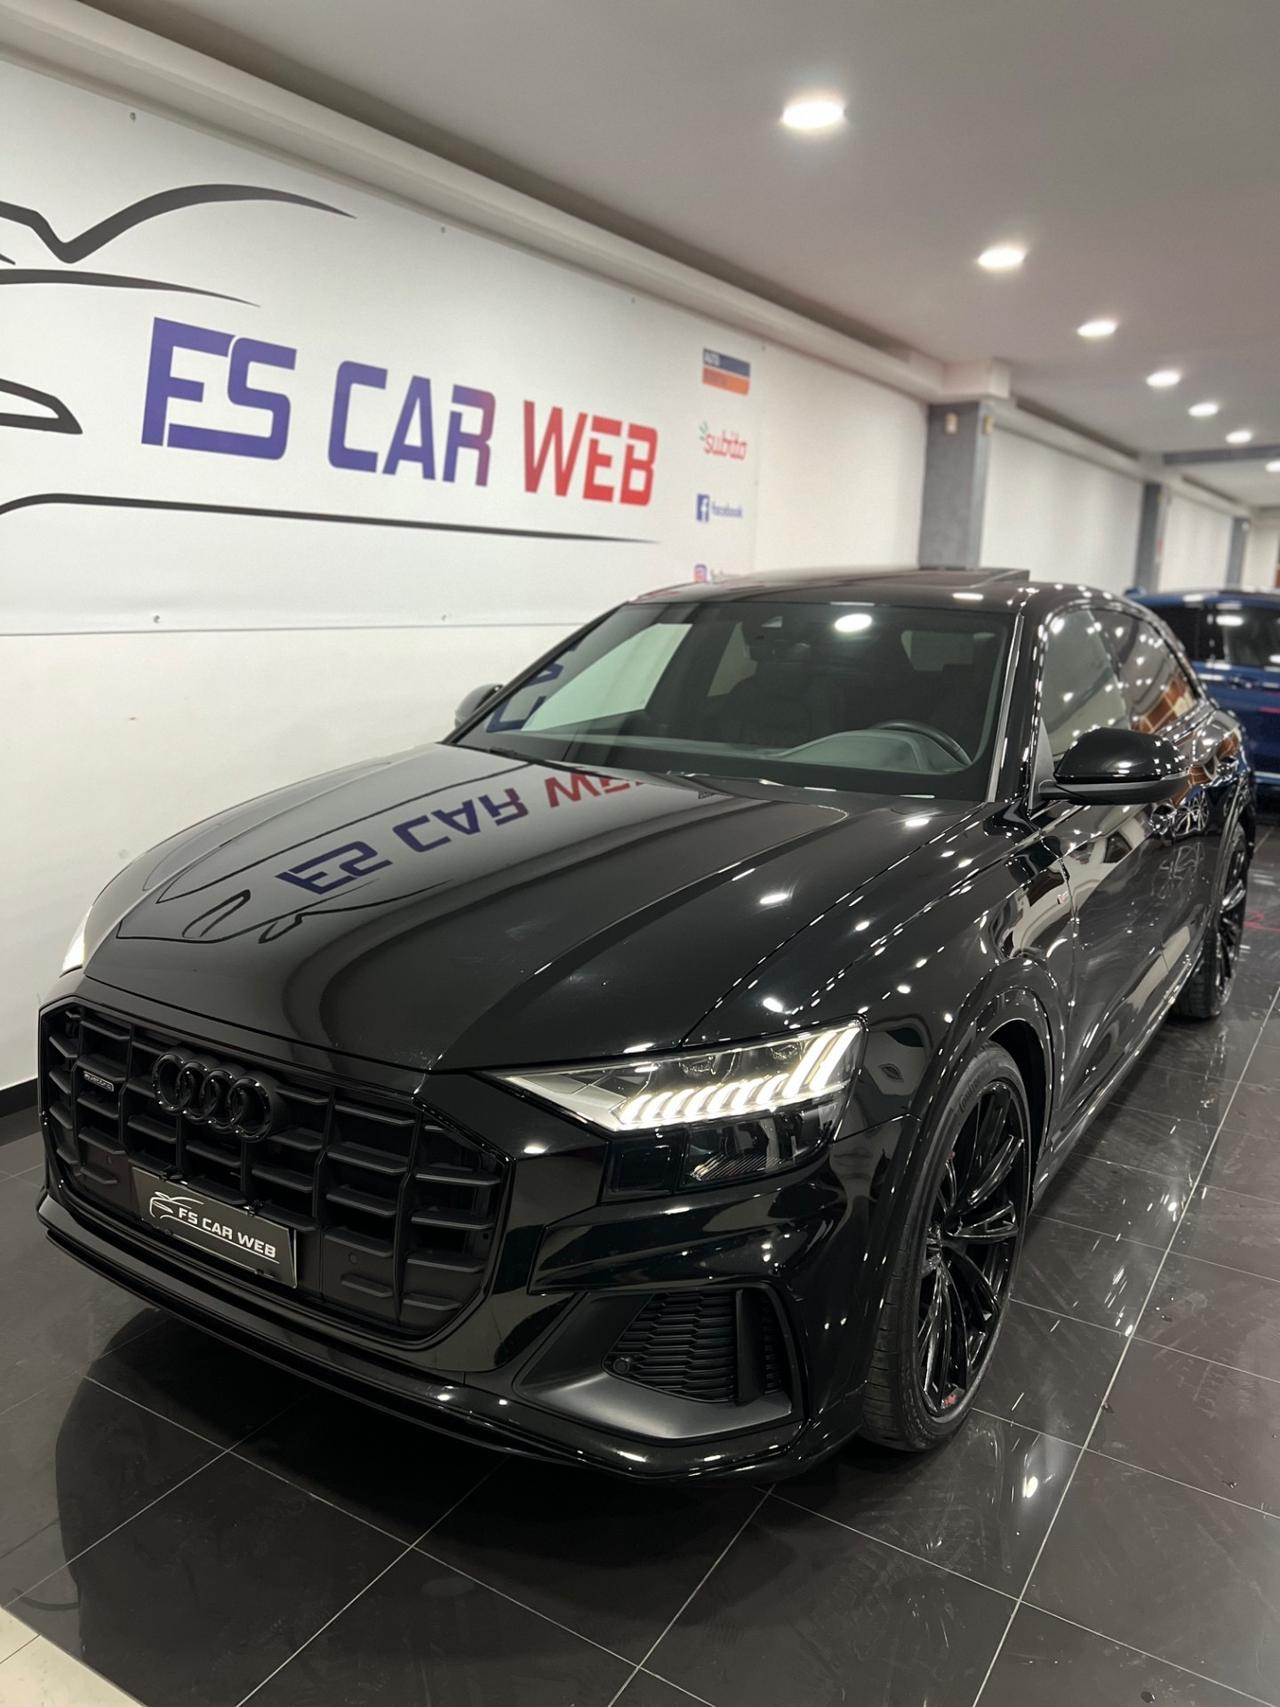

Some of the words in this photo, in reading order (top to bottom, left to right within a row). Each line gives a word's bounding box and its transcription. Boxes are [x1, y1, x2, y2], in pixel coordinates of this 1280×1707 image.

[328, 360, 496, 488] CAR
[523, 400, 658, 507] WEB
[178, 1207, 198, 1225] FS
[202, 1217, 232, 1240] CAR
[237, 1232, 276, 1258] WEB
